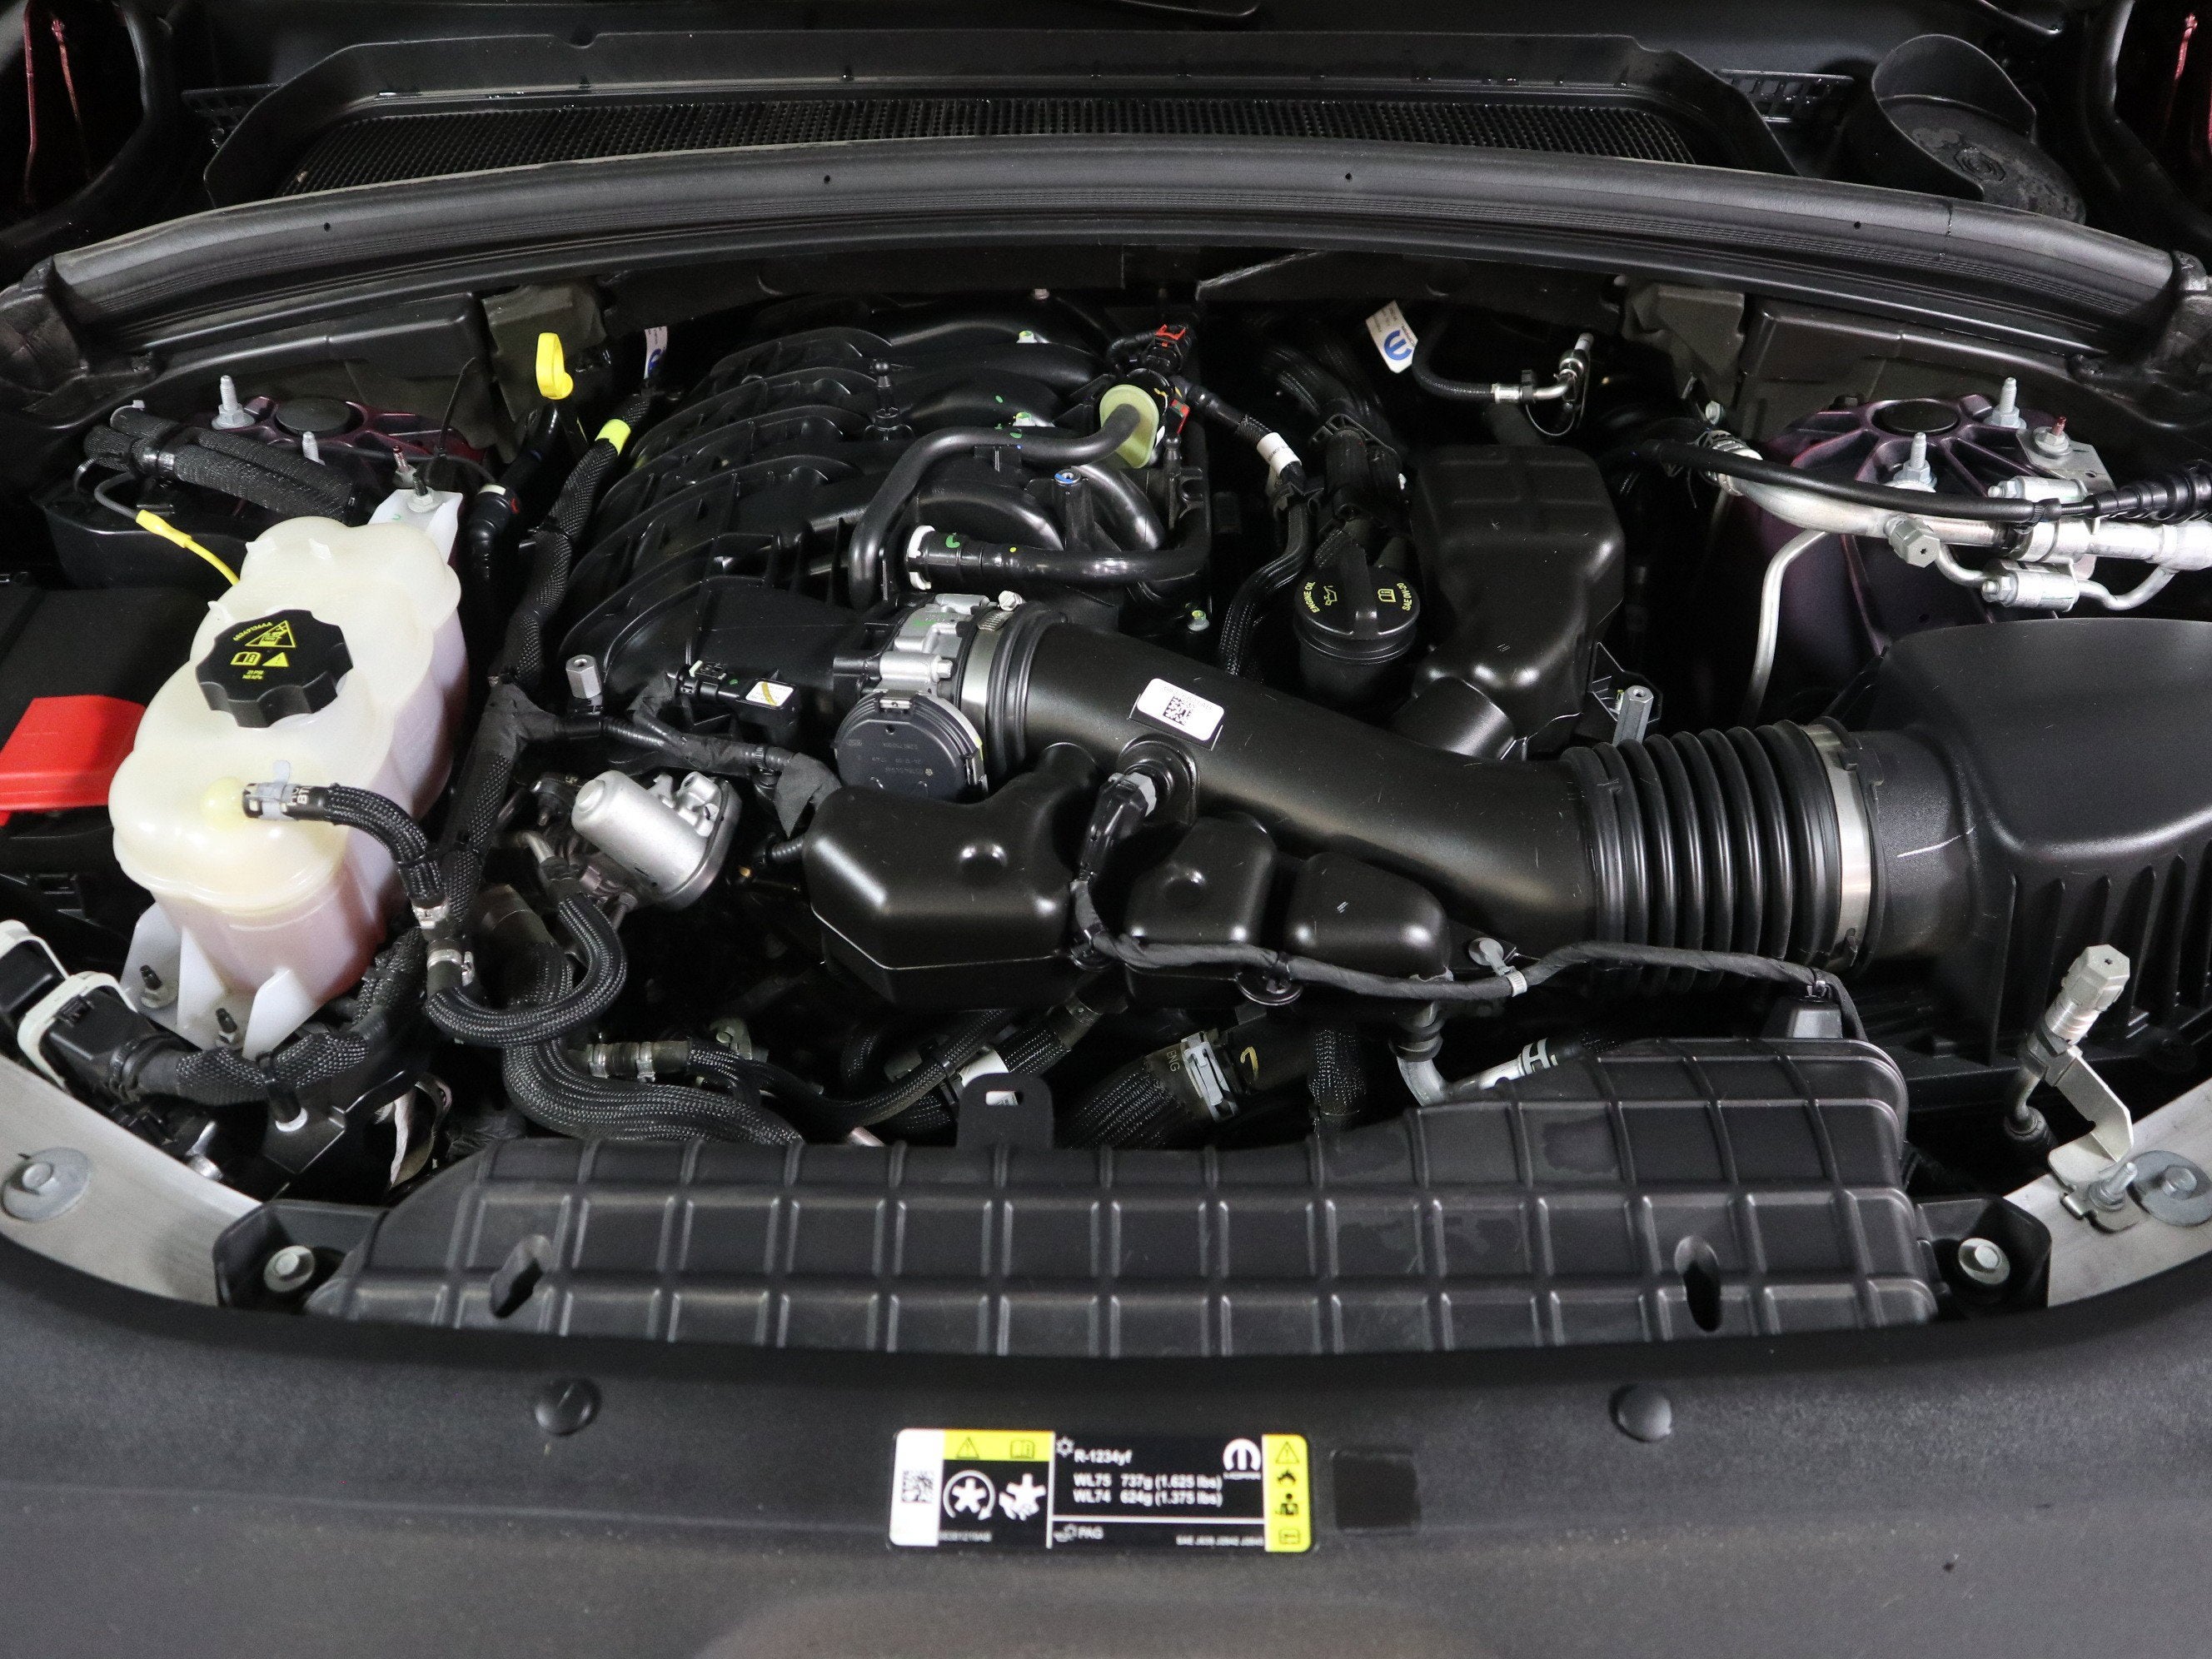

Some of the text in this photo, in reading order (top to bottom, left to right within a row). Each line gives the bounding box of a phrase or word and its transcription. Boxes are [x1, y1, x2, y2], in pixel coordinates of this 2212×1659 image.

[1303, 581, 1320, 613] ENGINE OIL
[1397, 582, 1412, 611] SAE 0W-20
[1166, 1049, 1180, 1072] ENG
[1074, 1448, 1133, 1466] R-1234yf
[1073, 1472, 1113, 1487] WL75
[1120, 1472, 1153, 1491] 737g
[1154, 1473, 1196, 1492] (1.625
[1196, 1473, 1223, 1492] lbs)
[1073, 1487, 1223, 1508] WL74 624g (1.375 lbs)
[1078, 1526, 1104, 1540] PAG
